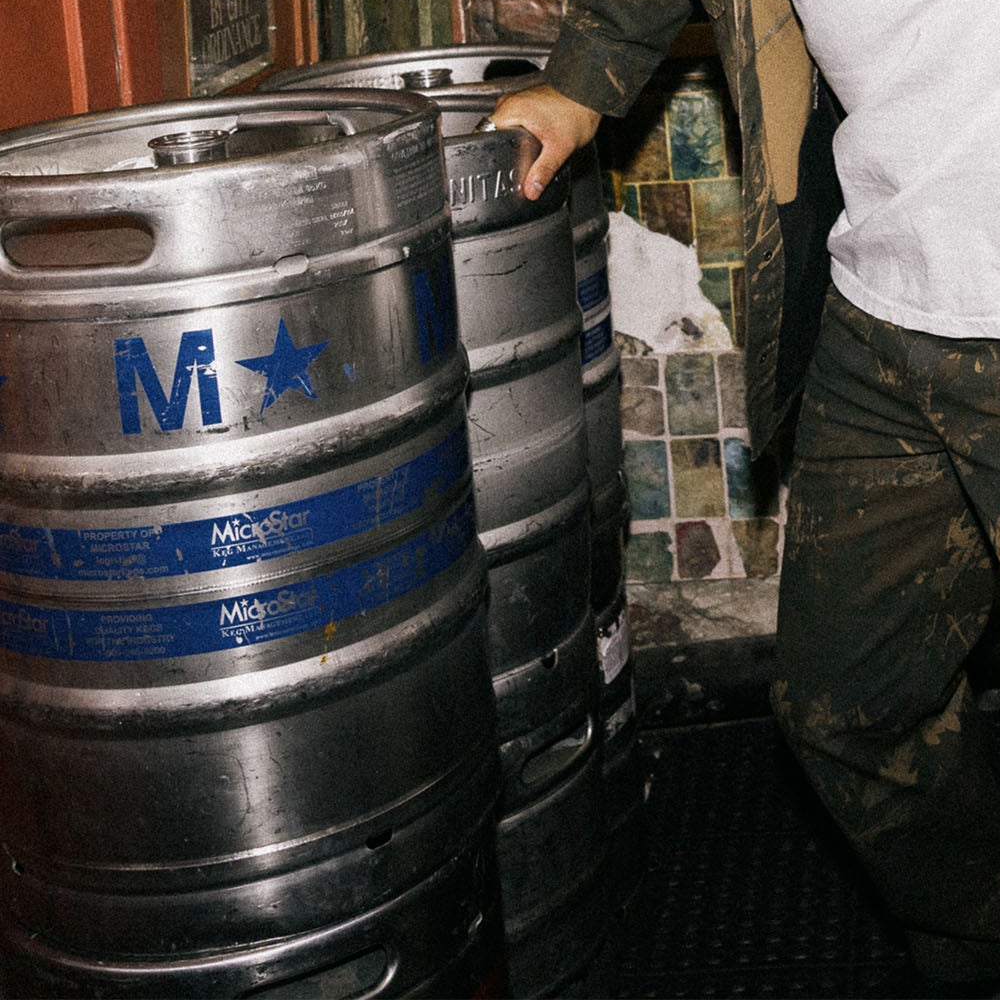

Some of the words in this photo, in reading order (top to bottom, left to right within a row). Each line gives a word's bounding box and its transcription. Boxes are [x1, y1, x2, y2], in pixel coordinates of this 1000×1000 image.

[201, 14, 262, 65] ORDINANCE
[114, 328, 222, 434] M
[83, 531, 138, 541] PROPERTY
[211, 509, 310, 545] MicroStar
[90, 542, 150, 553] MICROSTAR
[219, 589, 317, 626] MicroStar
